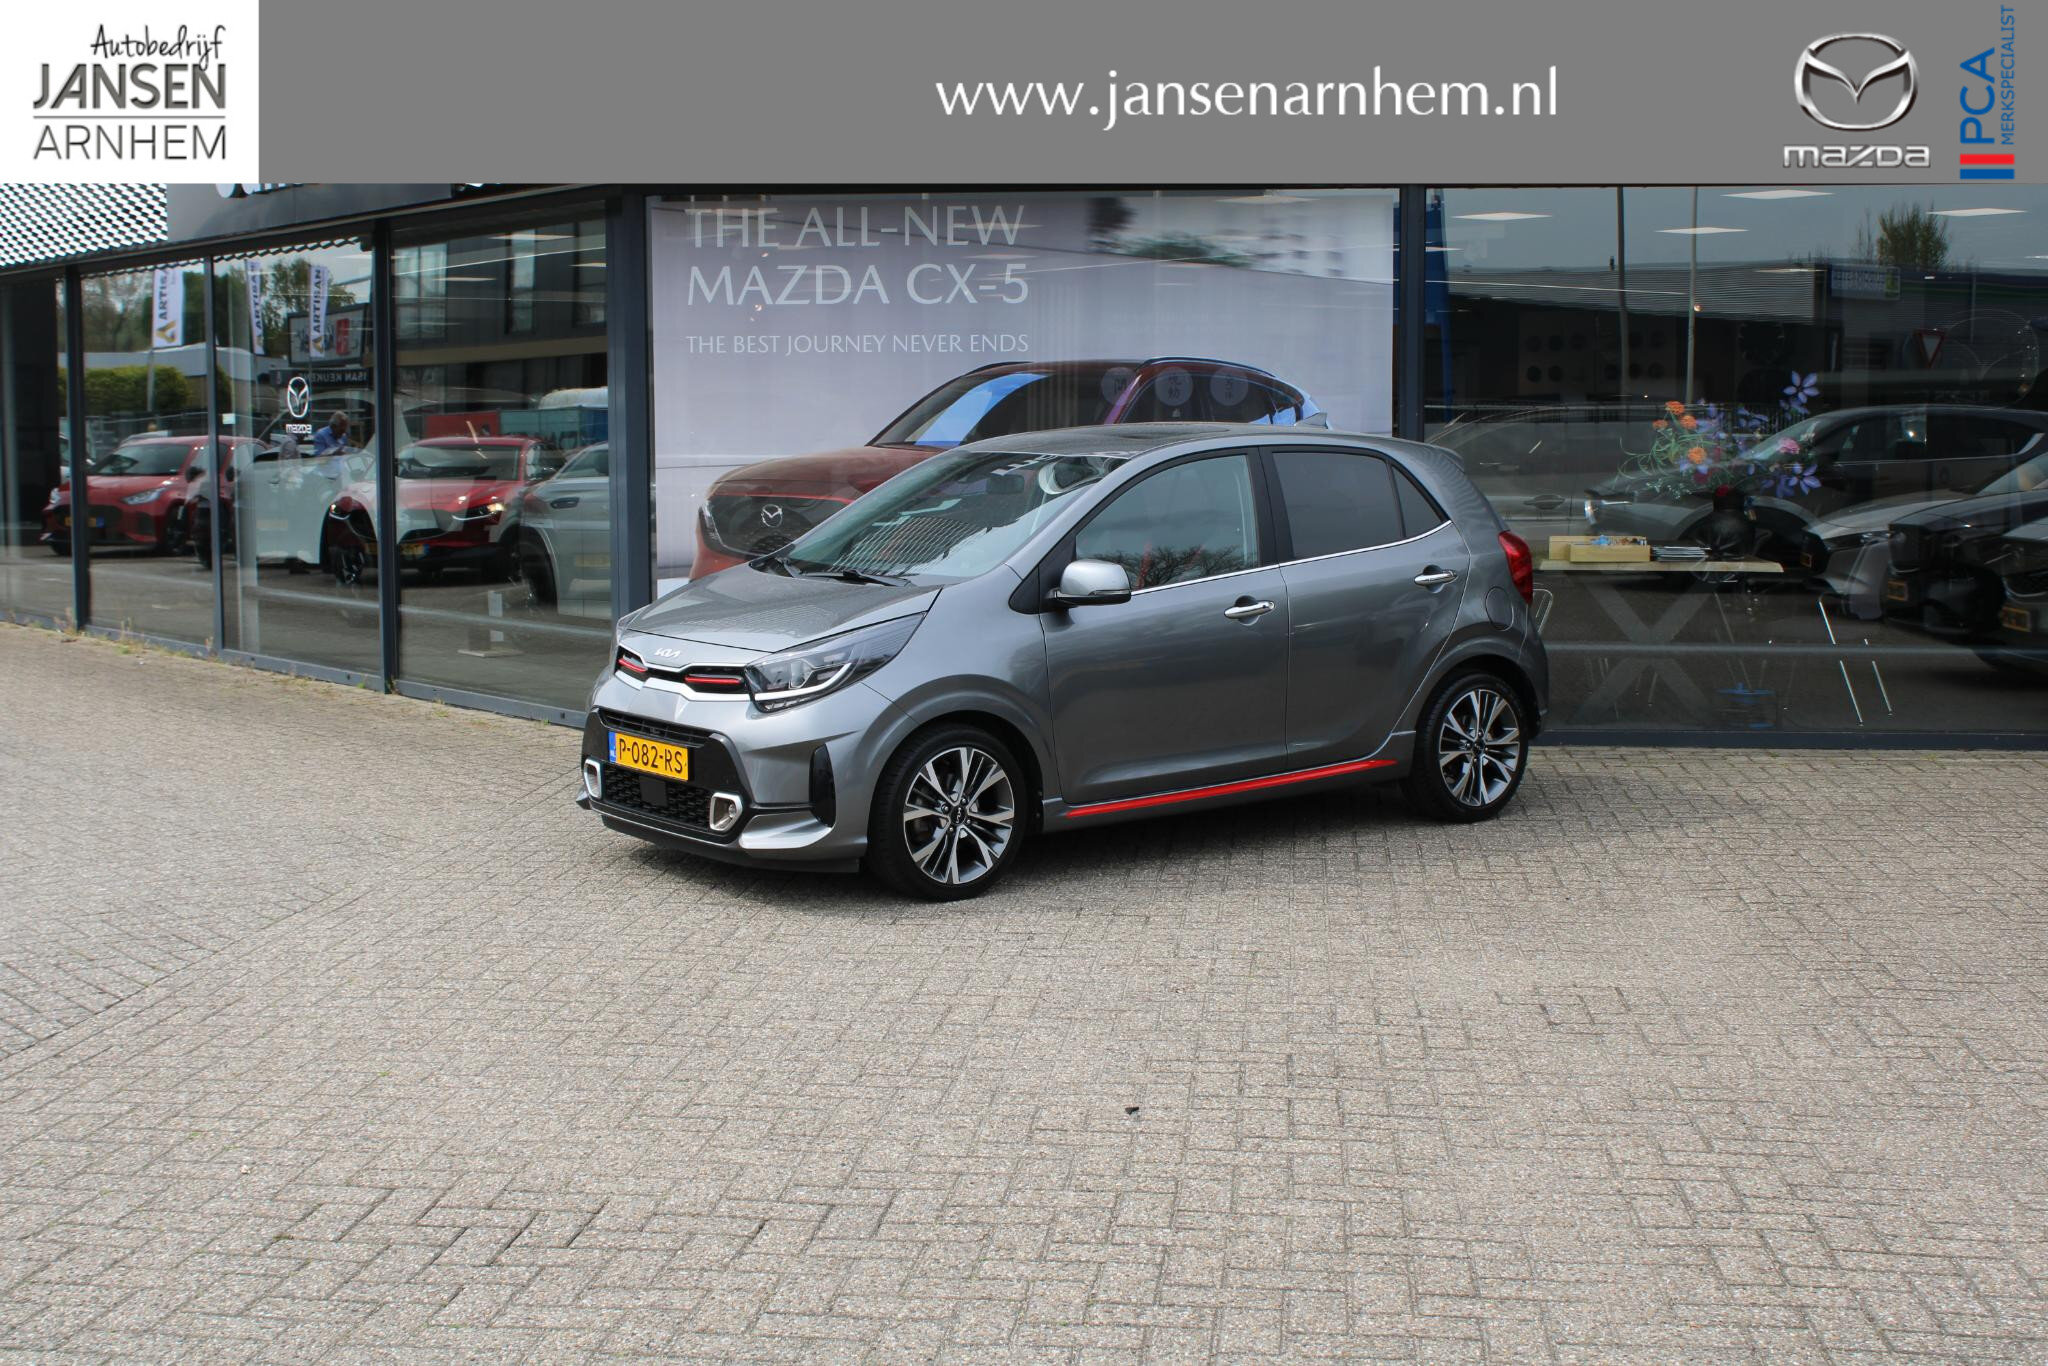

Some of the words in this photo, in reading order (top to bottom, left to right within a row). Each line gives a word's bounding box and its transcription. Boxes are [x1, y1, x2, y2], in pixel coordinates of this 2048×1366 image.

[685, 207, 781, 248] THE
[795, 205, 1025, 248] ALL-NEW
[312, 268, 322, 334] ARTISAN
[687, 264, 891, 306] MAZDA
[906, 263, 1029, 305] CX-5
[685, 335, 726, 353] THE
[733, 335, 781, 353] BEST
[786, 334, 886, 356] JOURNEY
[893, 334, 961, 353] NEVER
[970, 334, 1029, 353] ENDS
[619, 738, 683, 774] P-082-RS
